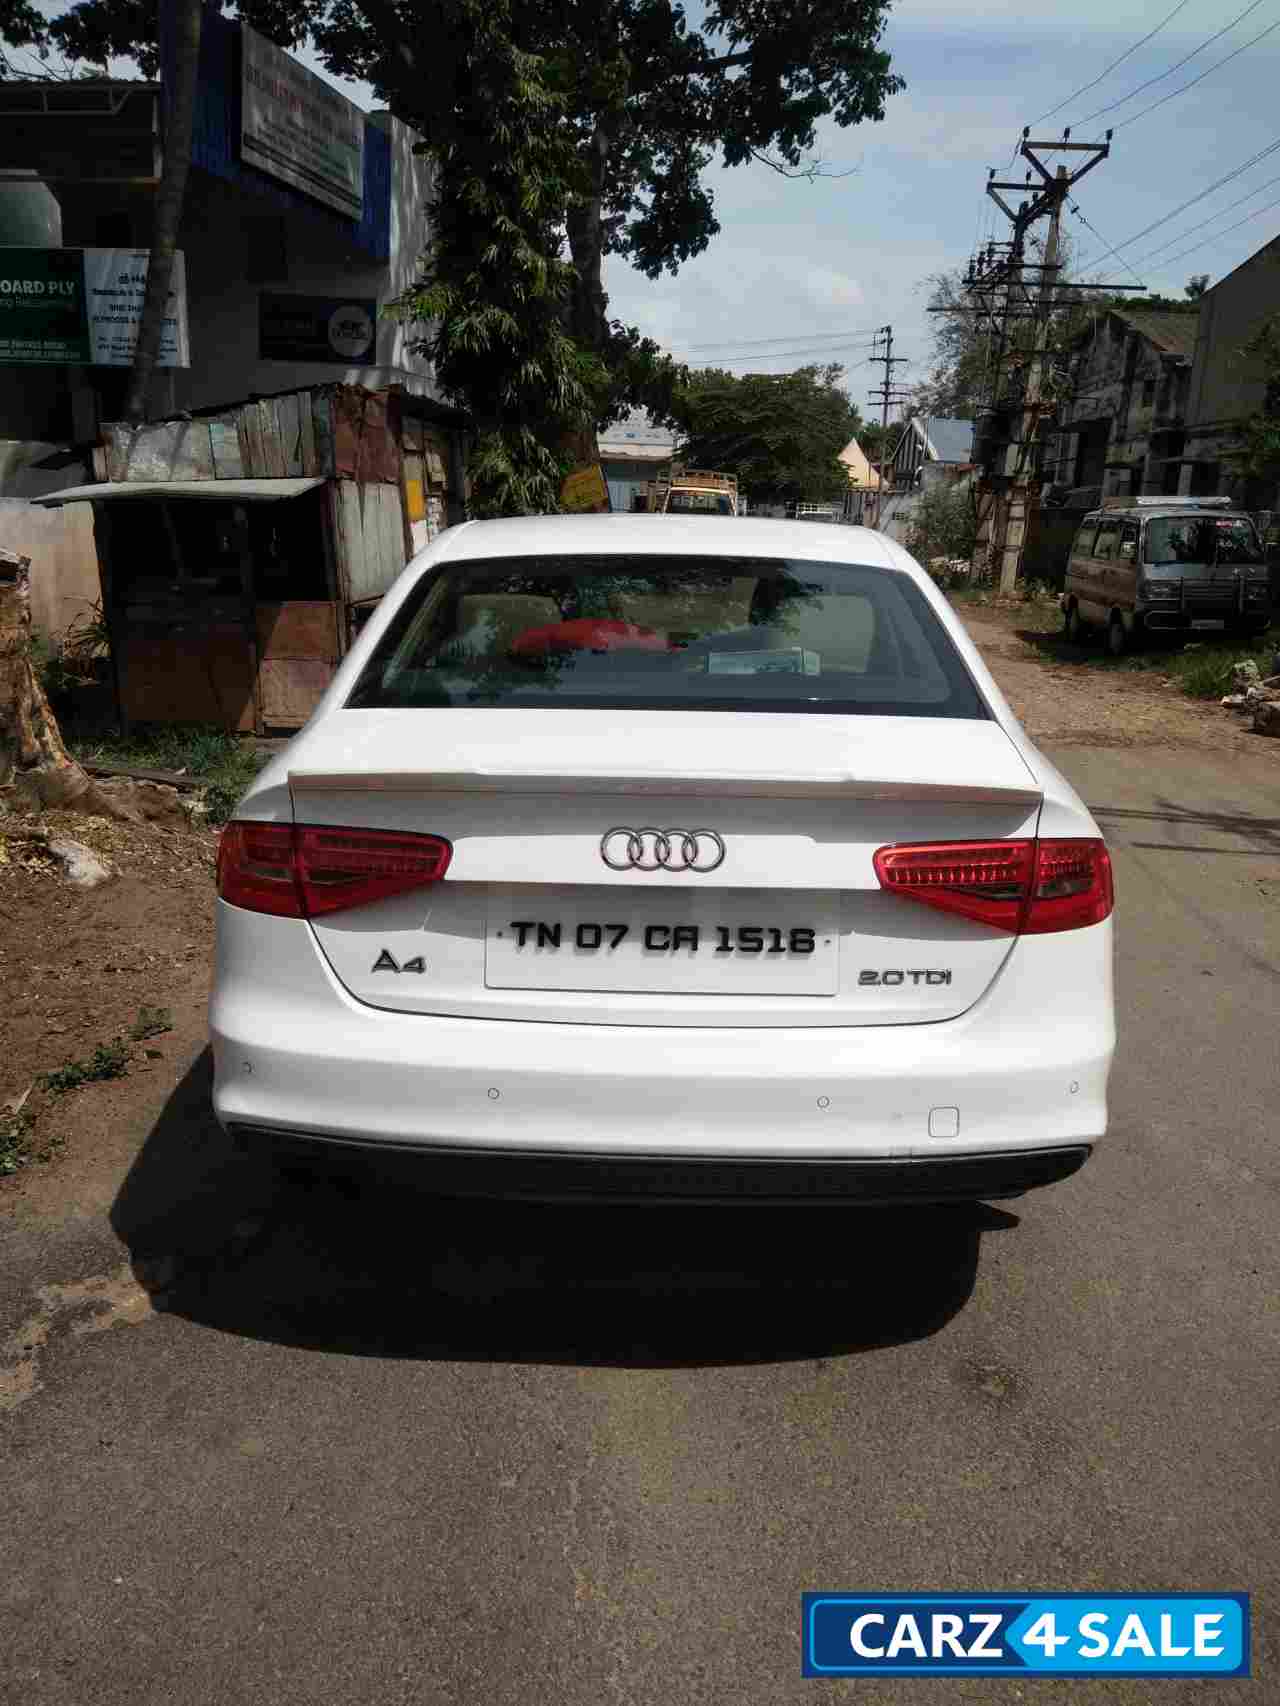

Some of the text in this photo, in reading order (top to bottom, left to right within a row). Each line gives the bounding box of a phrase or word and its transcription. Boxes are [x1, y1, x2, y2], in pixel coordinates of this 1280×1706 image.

[48, 280, 76, 295] PLY
[509, 921, 816, 954] TN 07 CA 1518
[371, 948, 426, 975] A4
[906, 969, 952, 985] TDI
